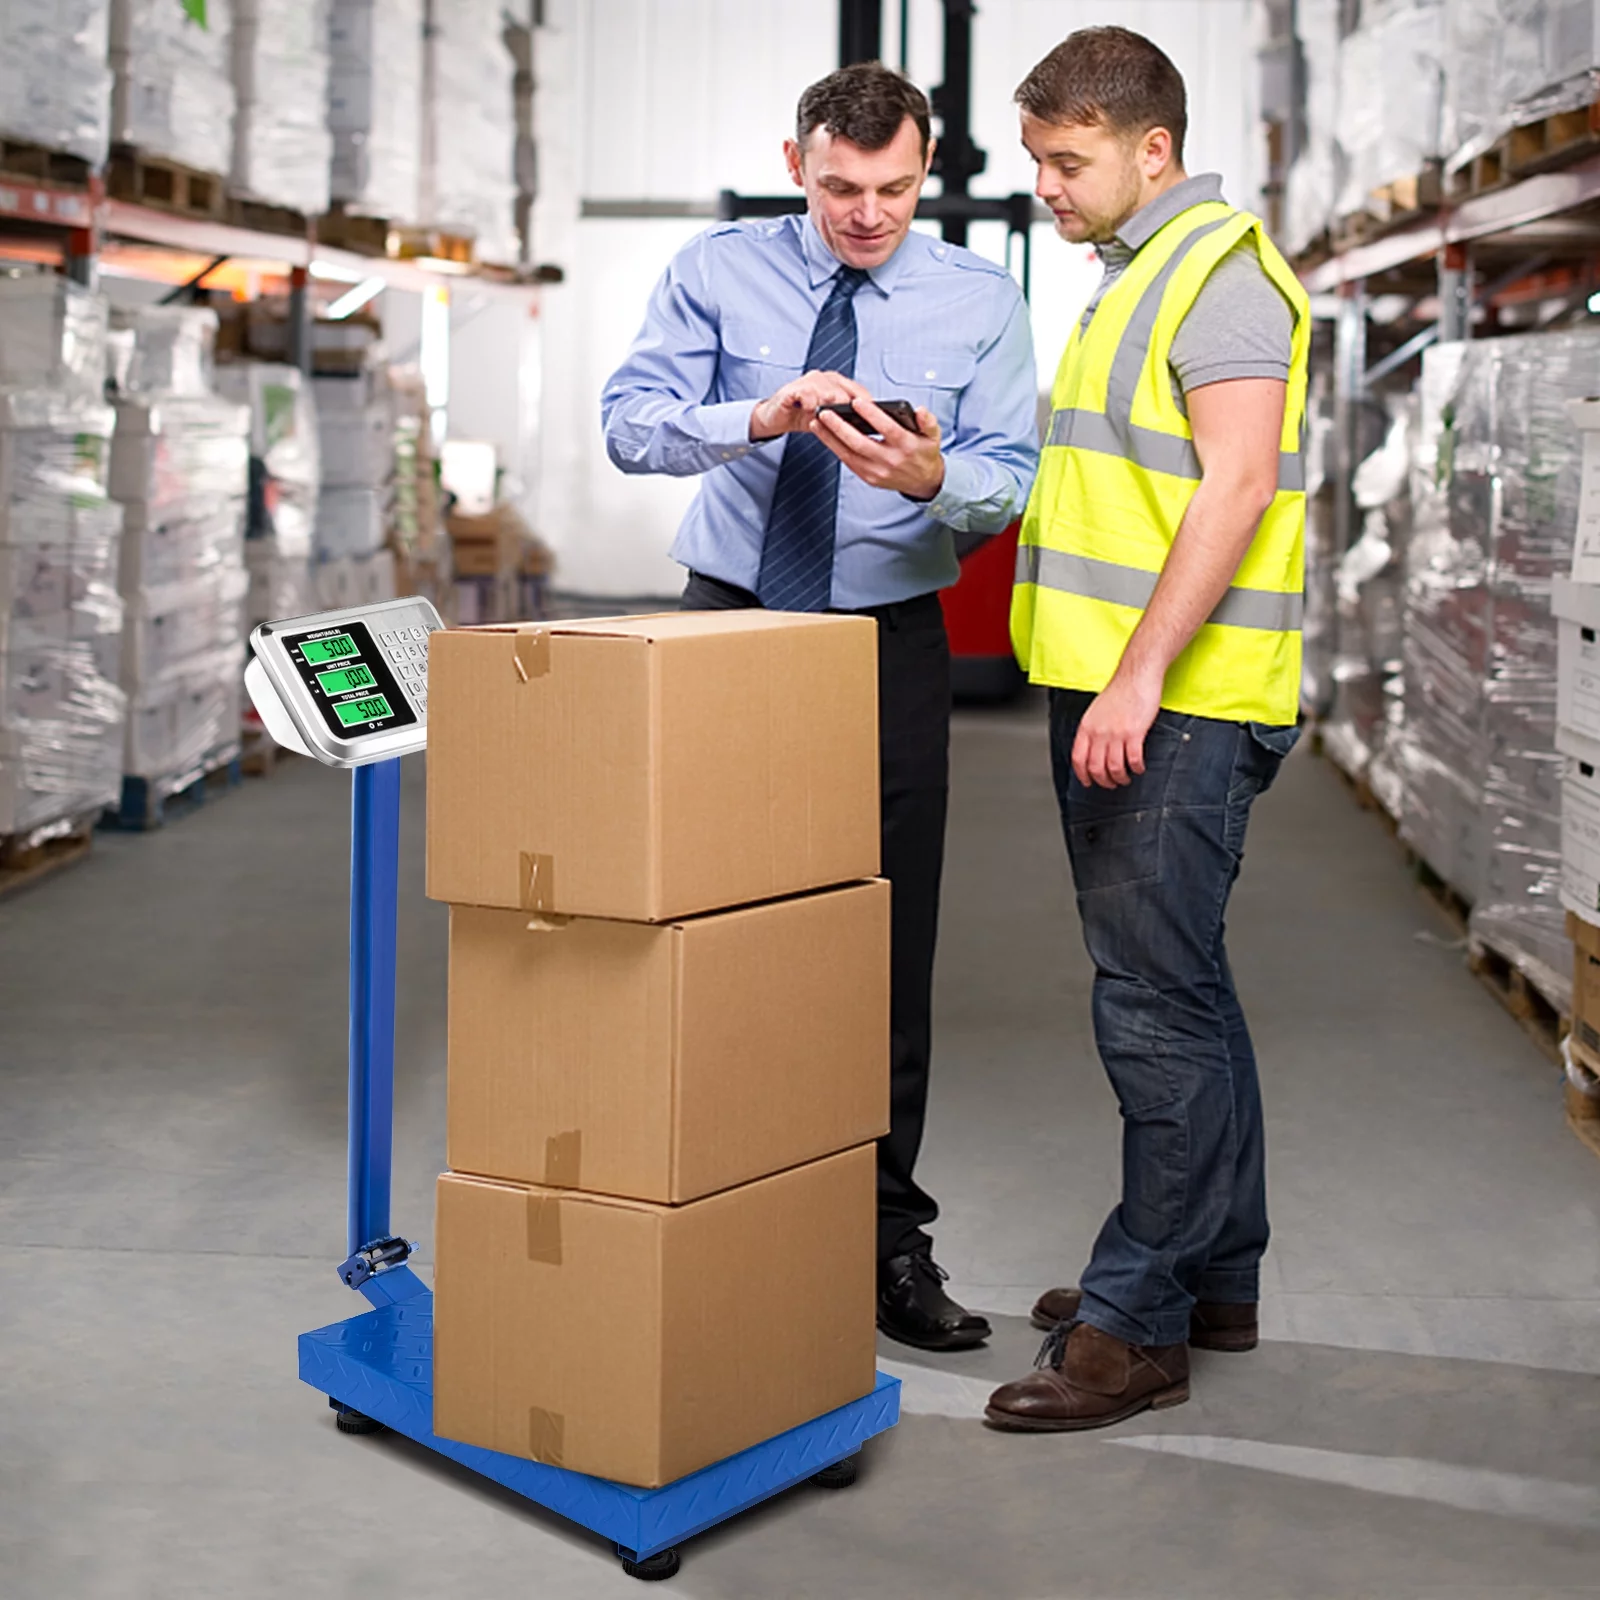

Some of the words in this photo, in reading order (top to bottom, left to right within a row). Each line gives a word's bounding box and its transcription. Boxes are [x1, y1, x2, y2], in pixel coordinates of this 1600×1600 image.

[386, 634, 393, 643] 1
[400, 631, 408, 641] 2
[413, 628, 421, 638] 3
[395, 651, 402, 659] 4
[408, 646, 417, 657] 5
[337, 660, 352, 668] PRICE
[403, 666, 410, 675] 7
[418, 663, 427, 673] 8
[413, 682, 421, 692] 0
[341, 692, 356, 700] TOTAL
[355, 690, 370, 698] PRICE
